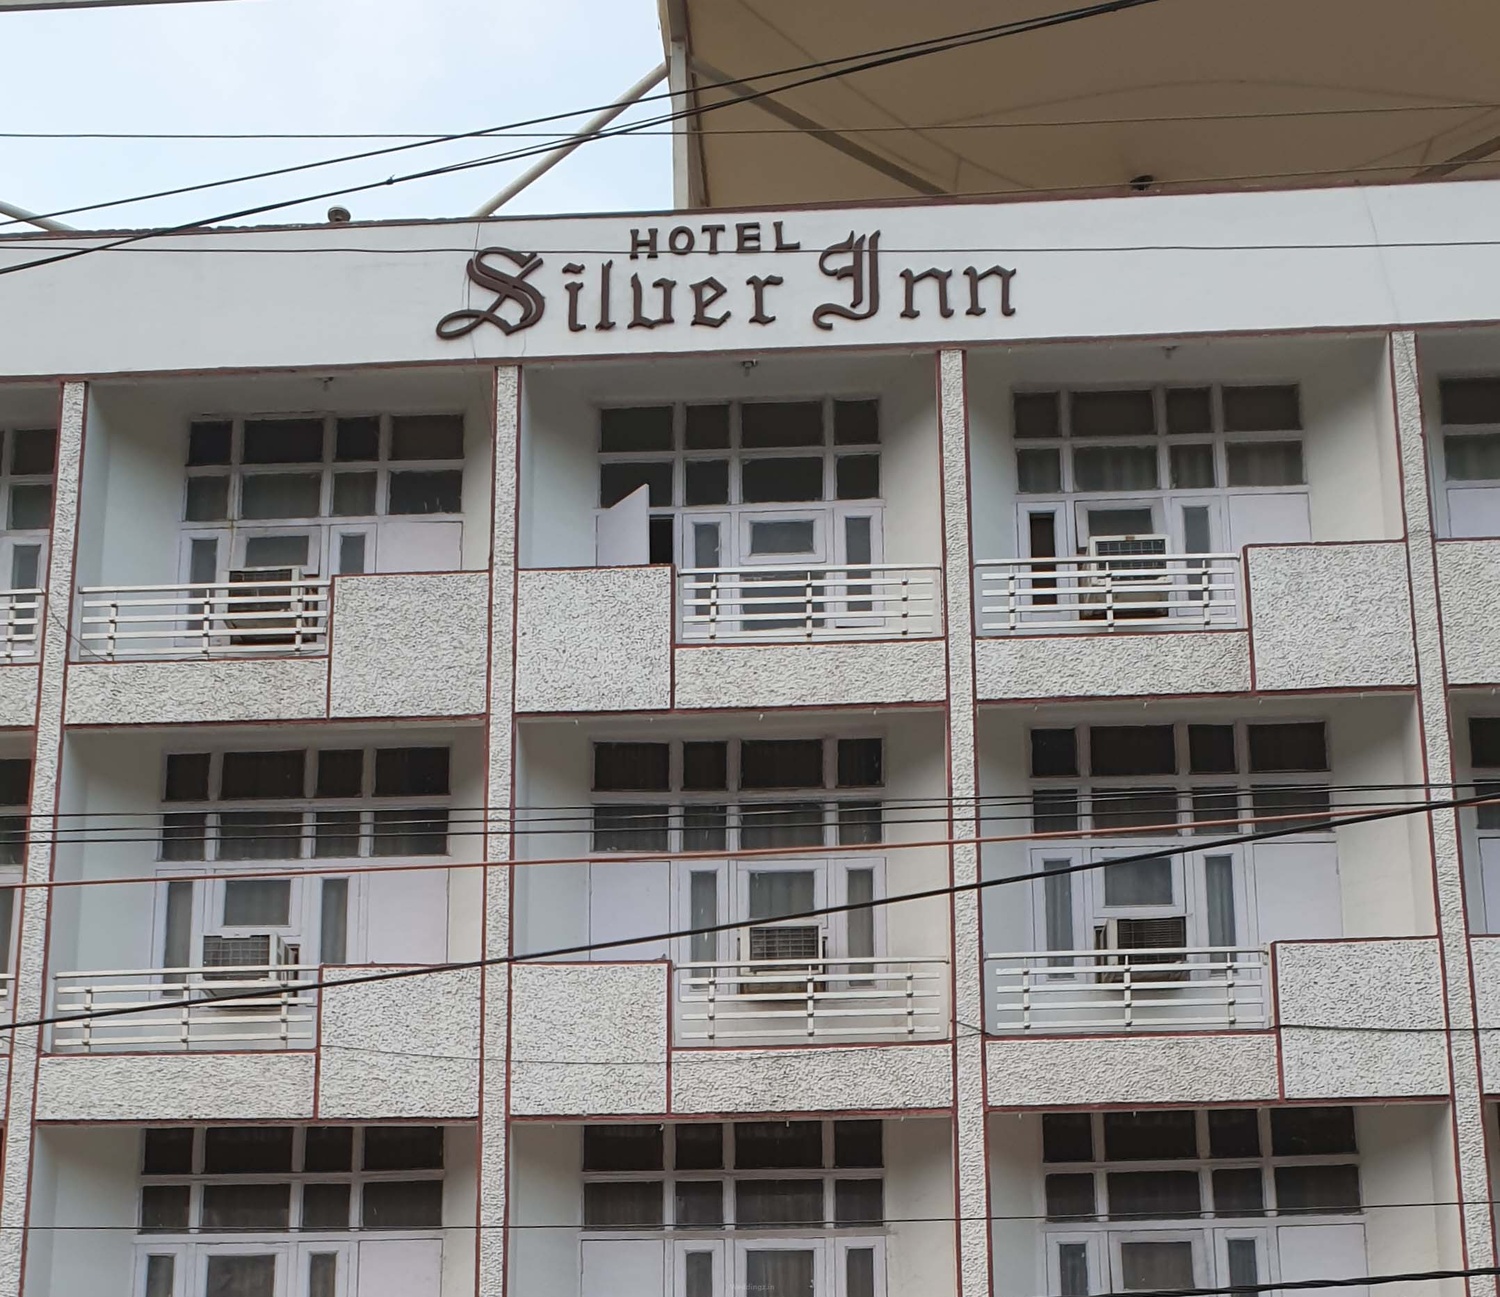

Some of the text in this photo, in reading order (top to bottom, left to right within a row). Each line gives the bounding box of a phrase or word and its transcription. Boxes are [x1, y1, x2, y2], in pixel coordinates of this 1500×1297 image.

[629, 220, 800, 260] HOTEL
[435, 229, 1017, 340] Silver Inn
